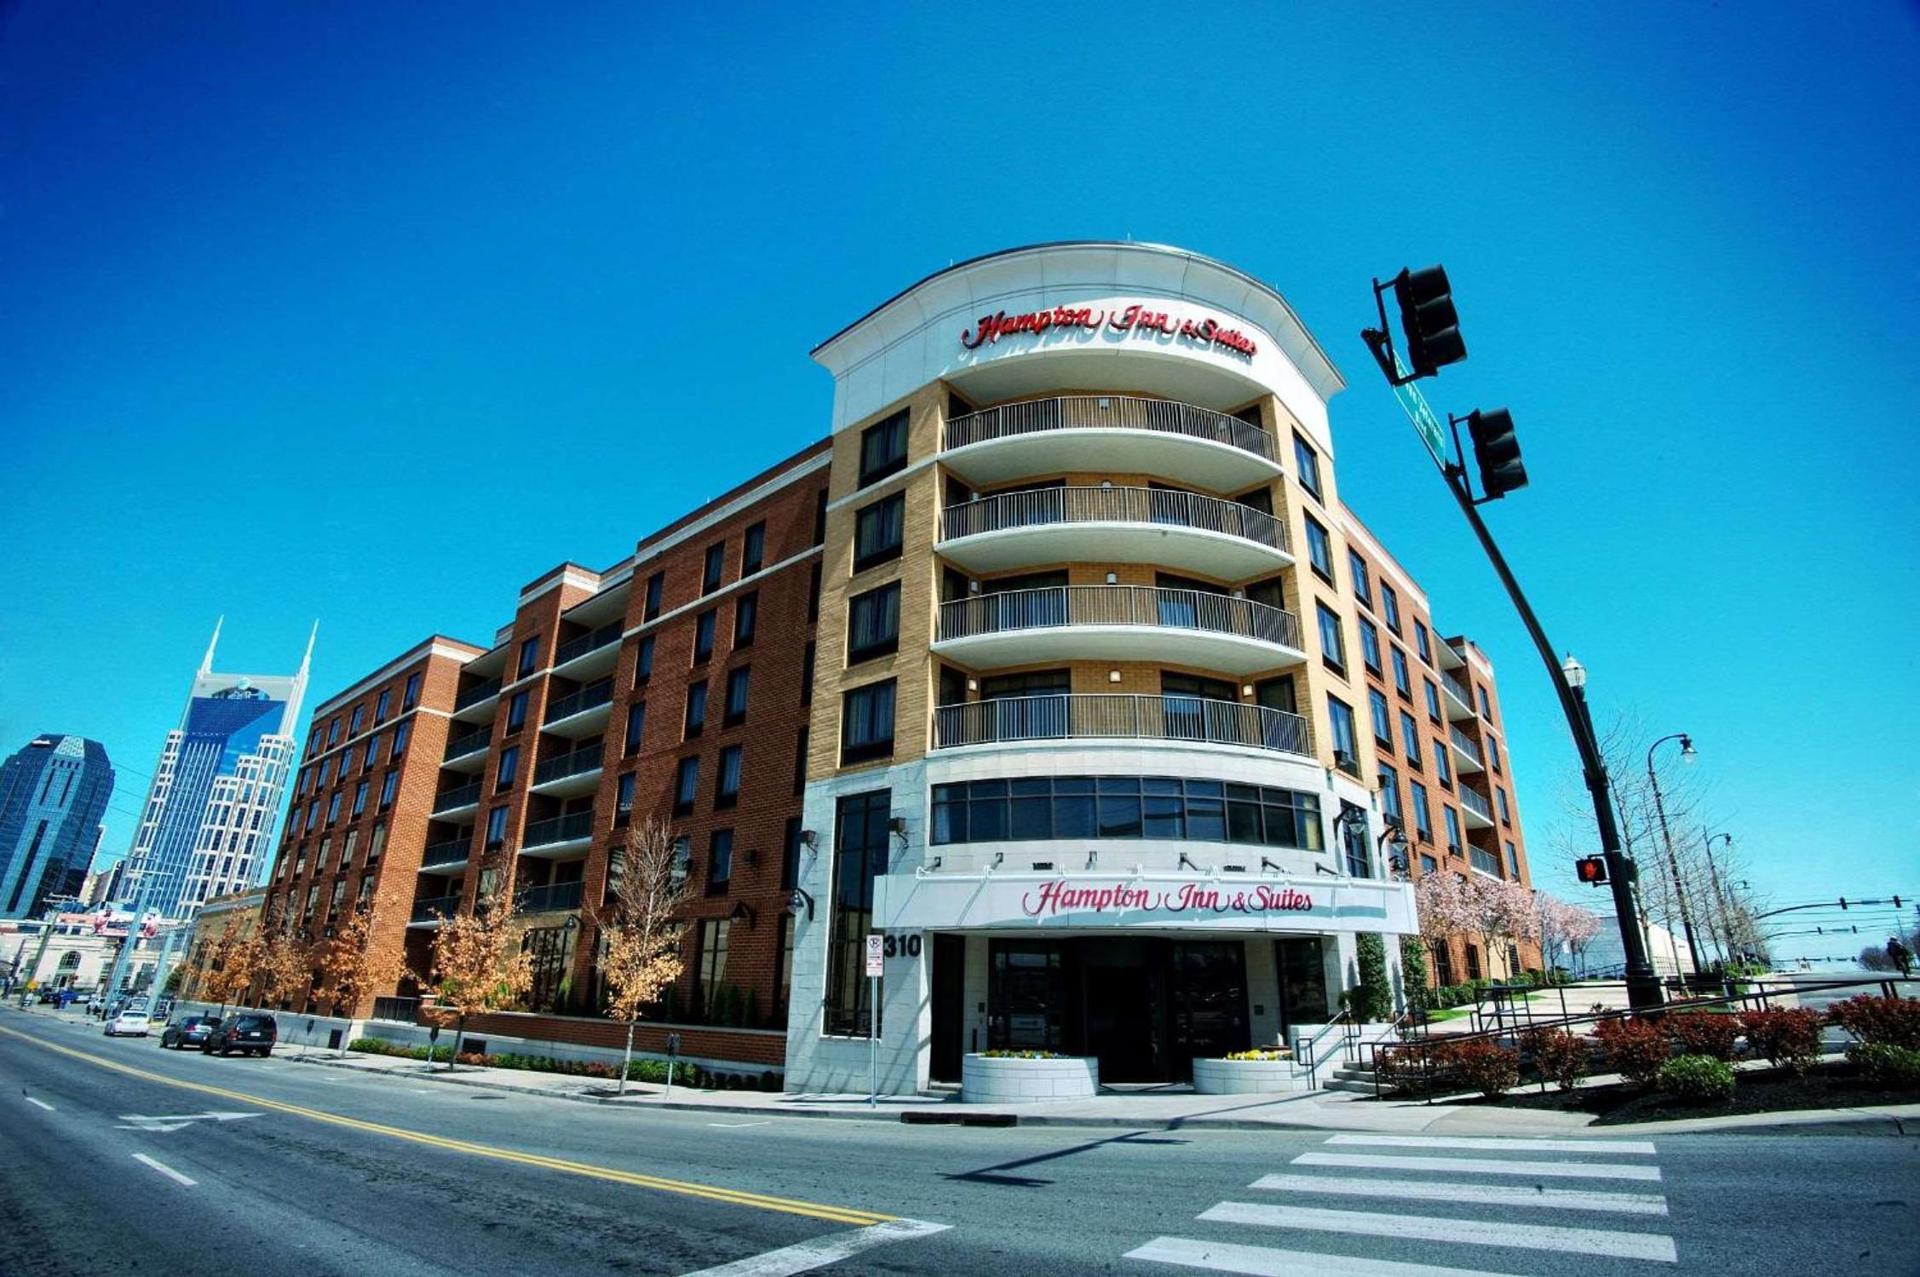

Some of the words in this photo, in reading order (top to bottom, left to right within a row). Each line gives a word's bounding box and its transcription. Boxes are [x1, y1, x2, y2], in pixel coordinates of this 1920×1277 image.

[961, 305, 1104, 350] Hampton
[1109, 304, 1180, 334] Inn
[1022, 880, 1161, 917] Hampton
[1164, 884, 1230, 913] Inn
[884, 934, 922, 958] 310
